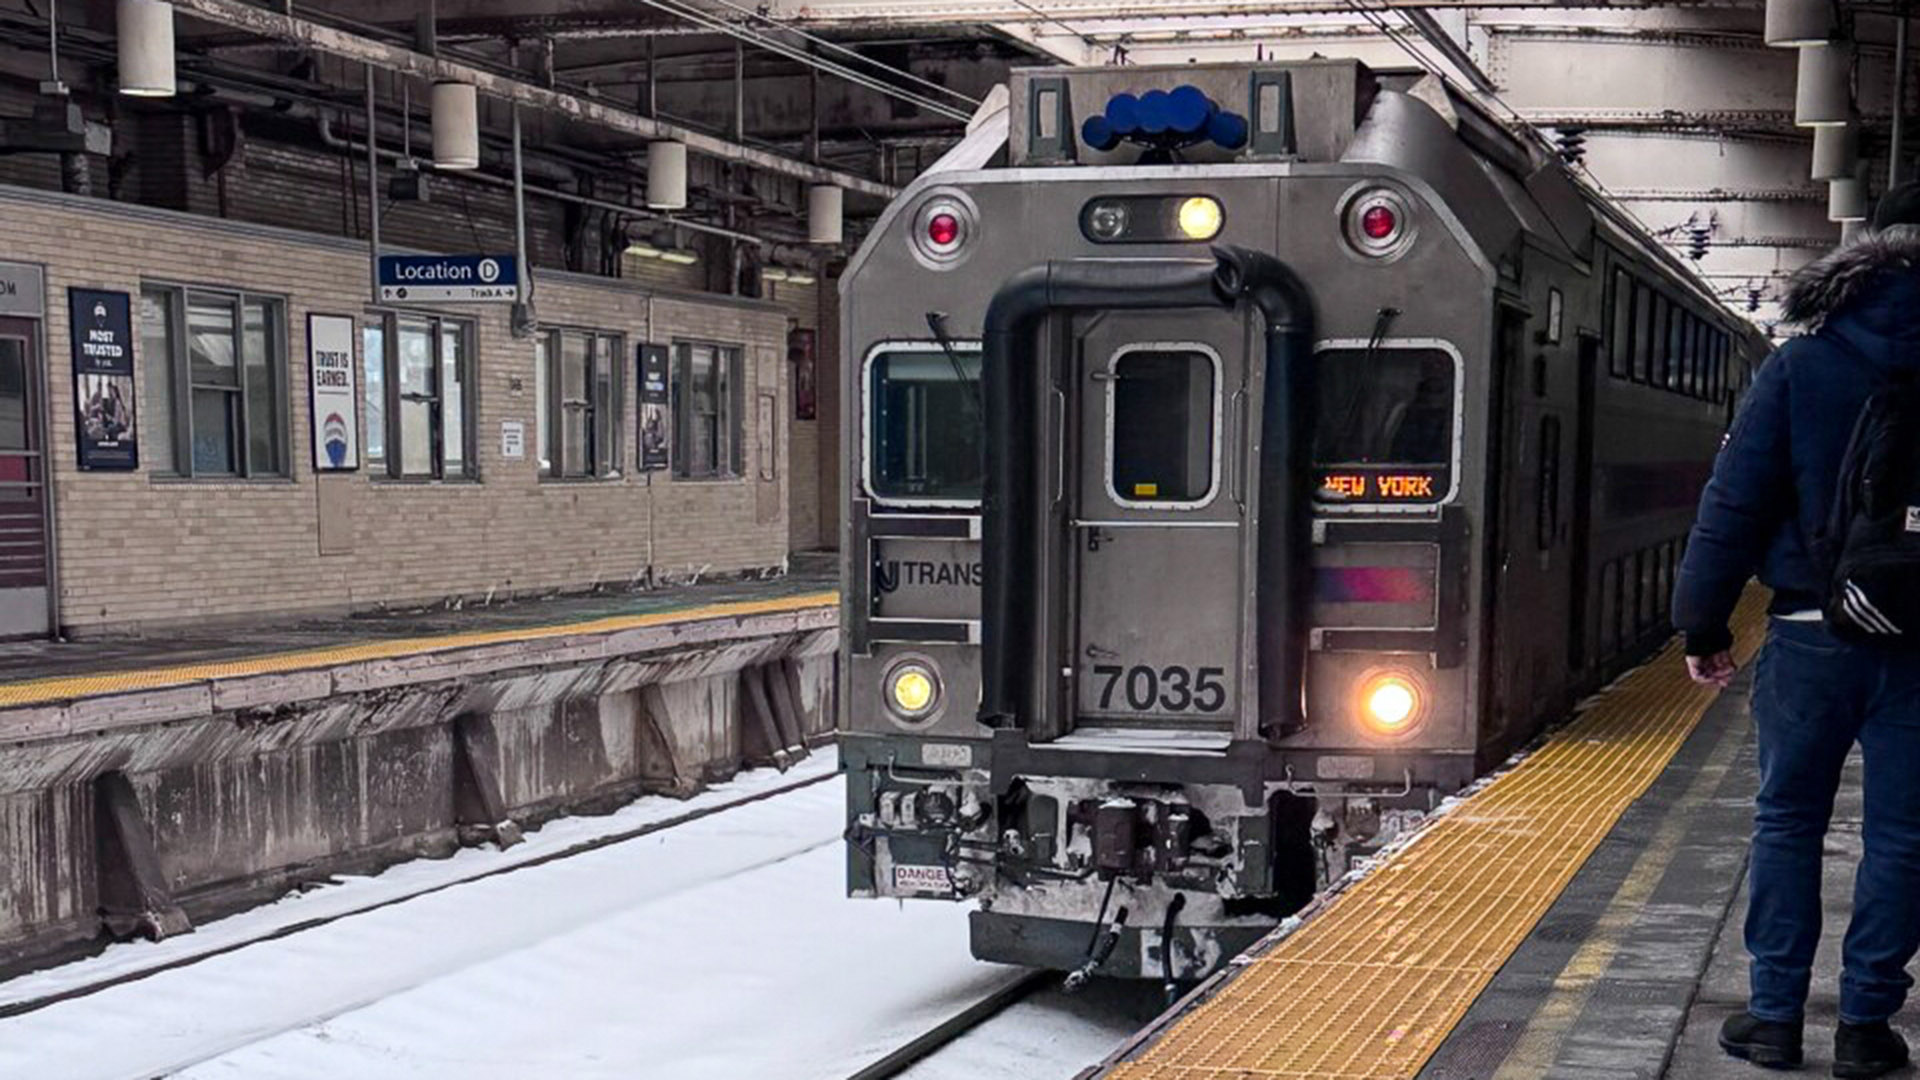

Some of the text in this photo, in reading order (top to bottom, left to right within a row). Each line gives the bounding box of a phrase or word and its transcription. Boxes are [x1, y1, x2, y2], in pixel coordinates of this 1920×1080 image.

[395, 260, 497, 280] Location D
[89, 330, 114, 342] MOST
[83, 342, 123, 357] TRUSTED
[316, 350, 349, 368] TRUST IS
[1377, 476, 1432, 496] YORK
[1093, 665, 1226, 712] 7035
[897, 867, 950, 880] DANGE
